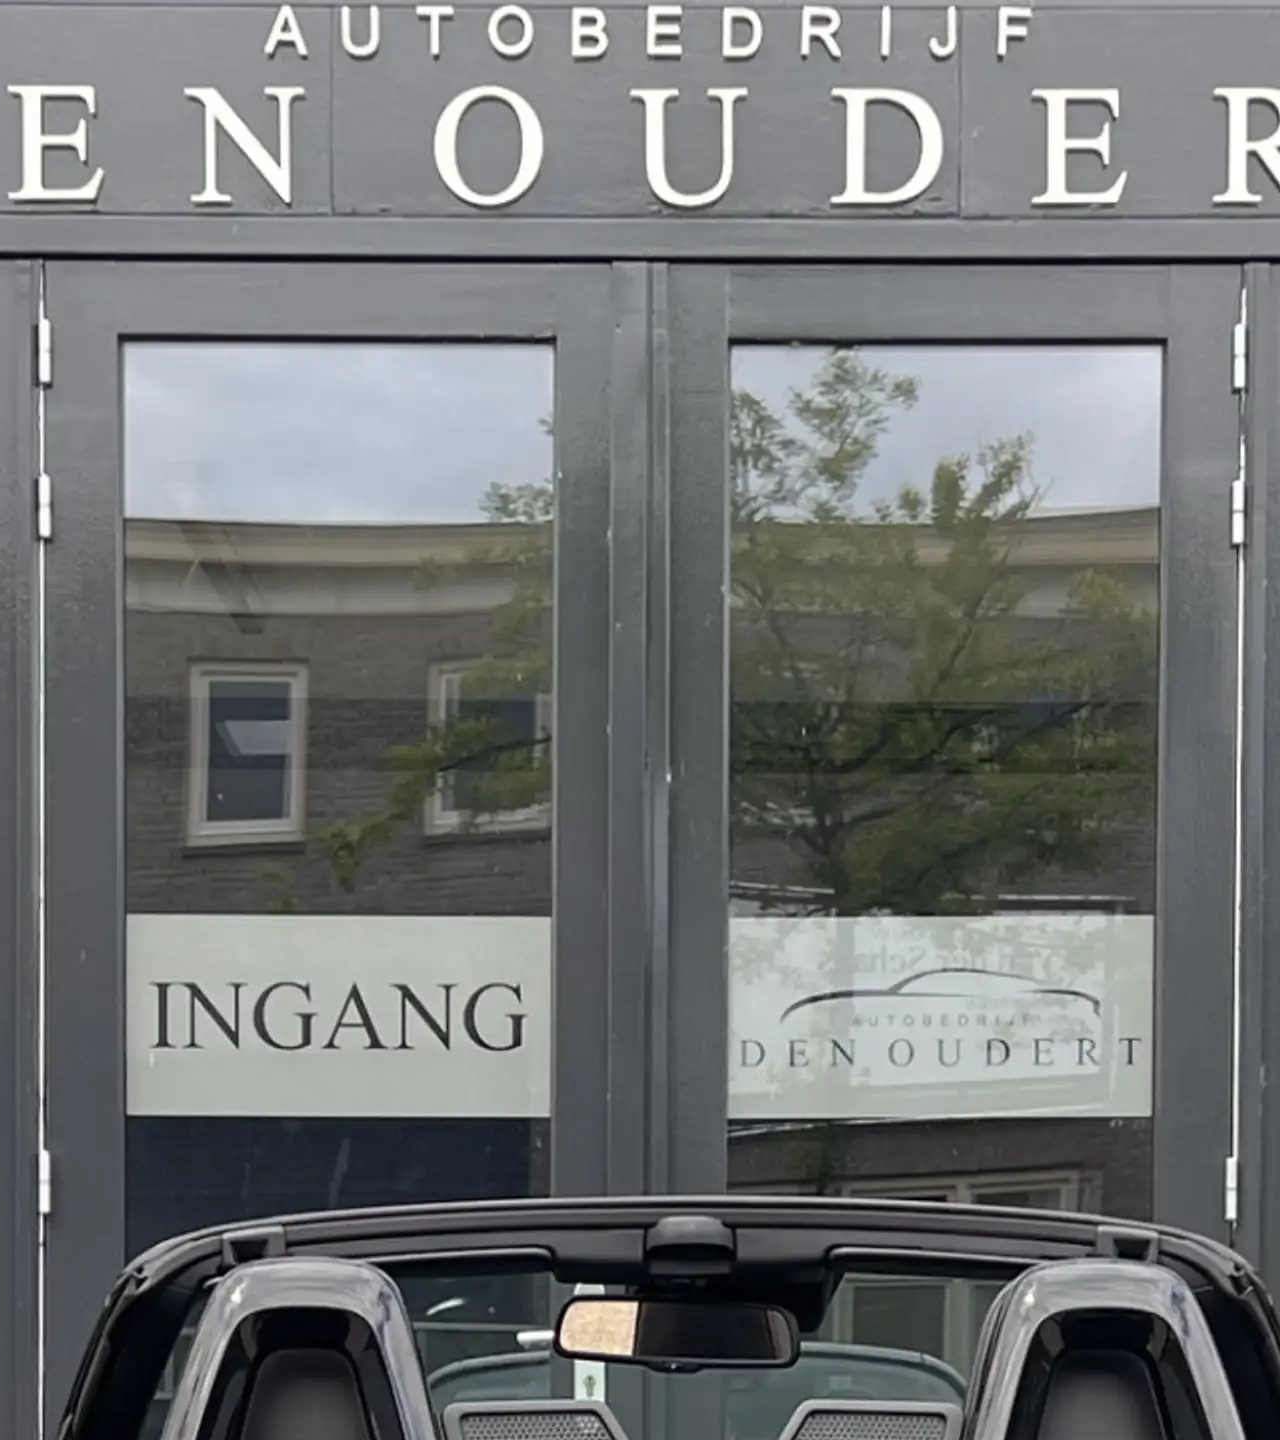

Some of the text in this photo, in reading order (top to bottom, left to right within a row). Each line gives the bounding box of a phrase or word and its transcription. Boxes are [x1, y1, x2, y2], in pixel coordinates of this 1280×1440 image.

[263, 5, 1033, 59] AUTOBEDRIJF
[148, 981, 529, 1052] INGANG
[740, 1037, 1142, 1068] DEN OUDERT
